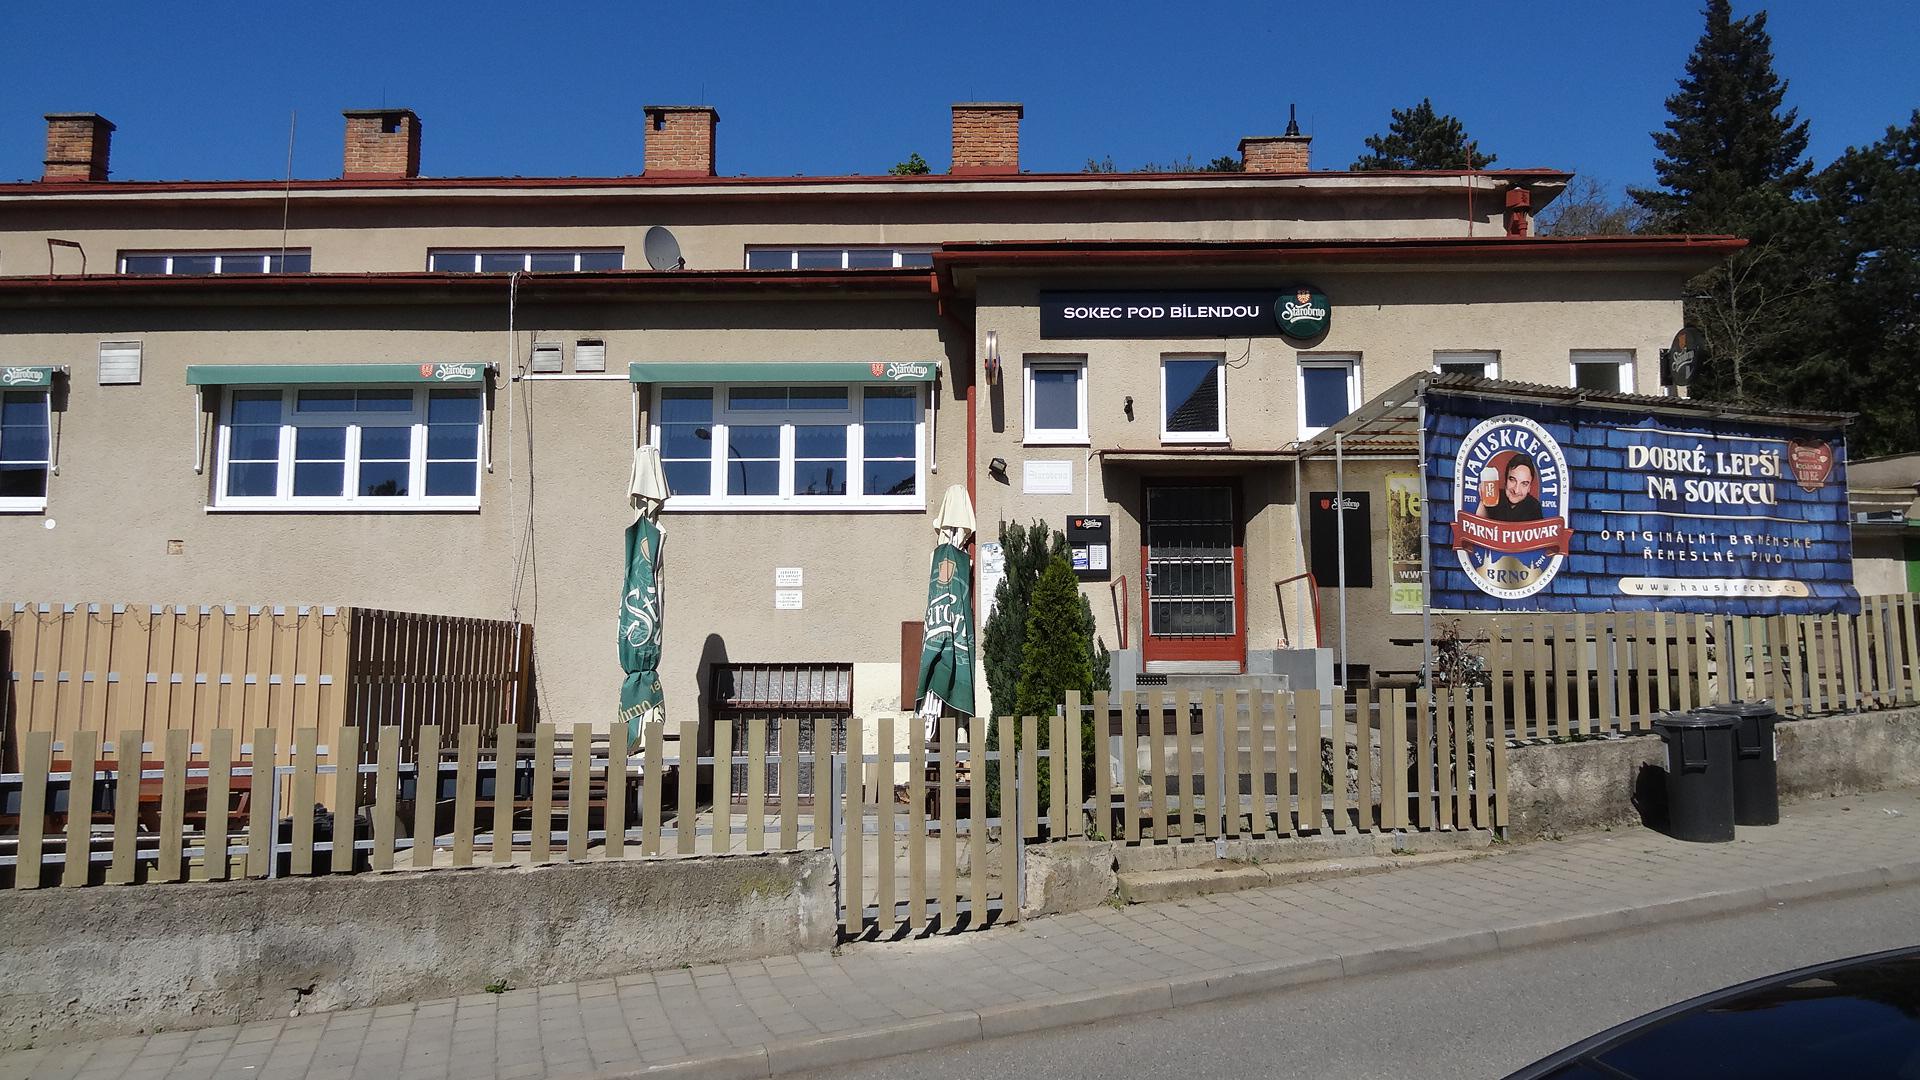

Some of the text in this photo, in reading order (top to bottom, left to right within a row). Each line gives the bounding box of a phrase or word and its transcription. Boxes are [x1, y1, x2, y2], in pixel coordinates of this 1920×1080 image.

[1063, 306, 1122, 319] SOKEC
[1127, 306, 1165, 318] POD
[1281, 302, 1326, 323] Starobrno
[886, 361, 928, 380] Starobrno
[1464, 429, 1558, 497] HAUSKRECHT
[1628, 444, 1711, 475] DOBRÉ,
[1716, 449, 1783, 479] LEPŠÍ,
[1647, 476, 1677, 500] NA
[1462, 520, 1558, 543] PARNÍ PIVOVAR
[1601, 530, 1716, 545] ORIGINÁLNÍ
[1643, 546, 1782, 564] ŘEMESLNÉ PIVO
[1487, 569, 1529, 584] BRNO
[1635, 582, 1797, 593] www.hauskrecht.cz
